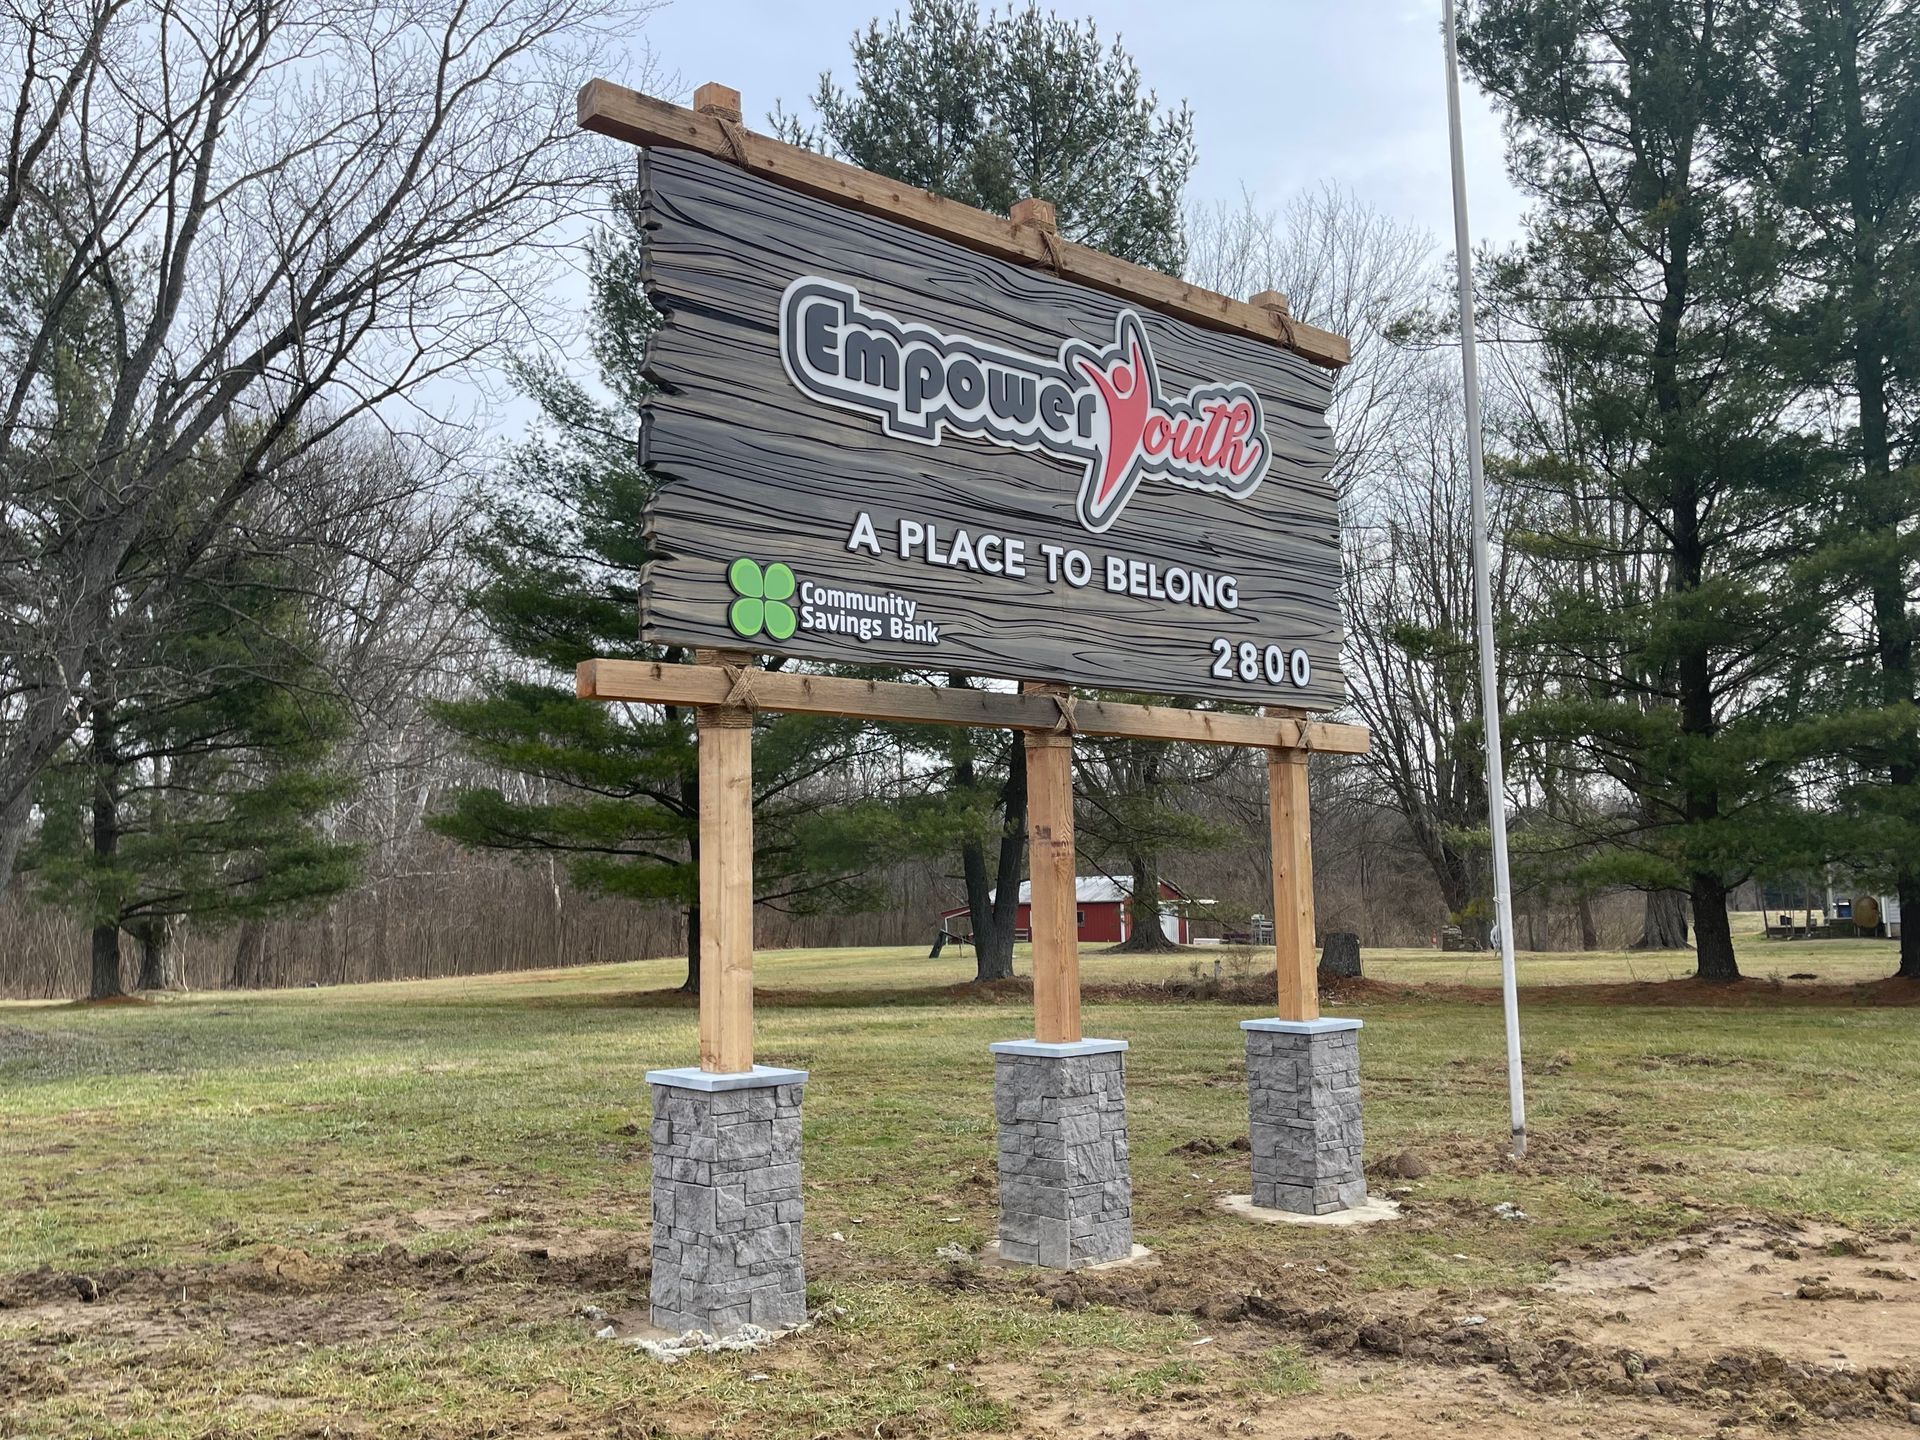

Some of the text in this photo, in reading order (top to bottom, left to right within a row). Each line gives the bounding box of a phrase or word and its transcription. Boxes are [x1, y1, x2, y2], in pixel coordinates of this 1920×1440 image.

[805, 303, 1096, 437] Empower
[848, 512, 1239, 610] A PLACE TO BELONG
[801, 582, 917, 621] Community
[802, 607, 939, 643] Savings Bank
[1212, 638, 1311, 687] 2800
